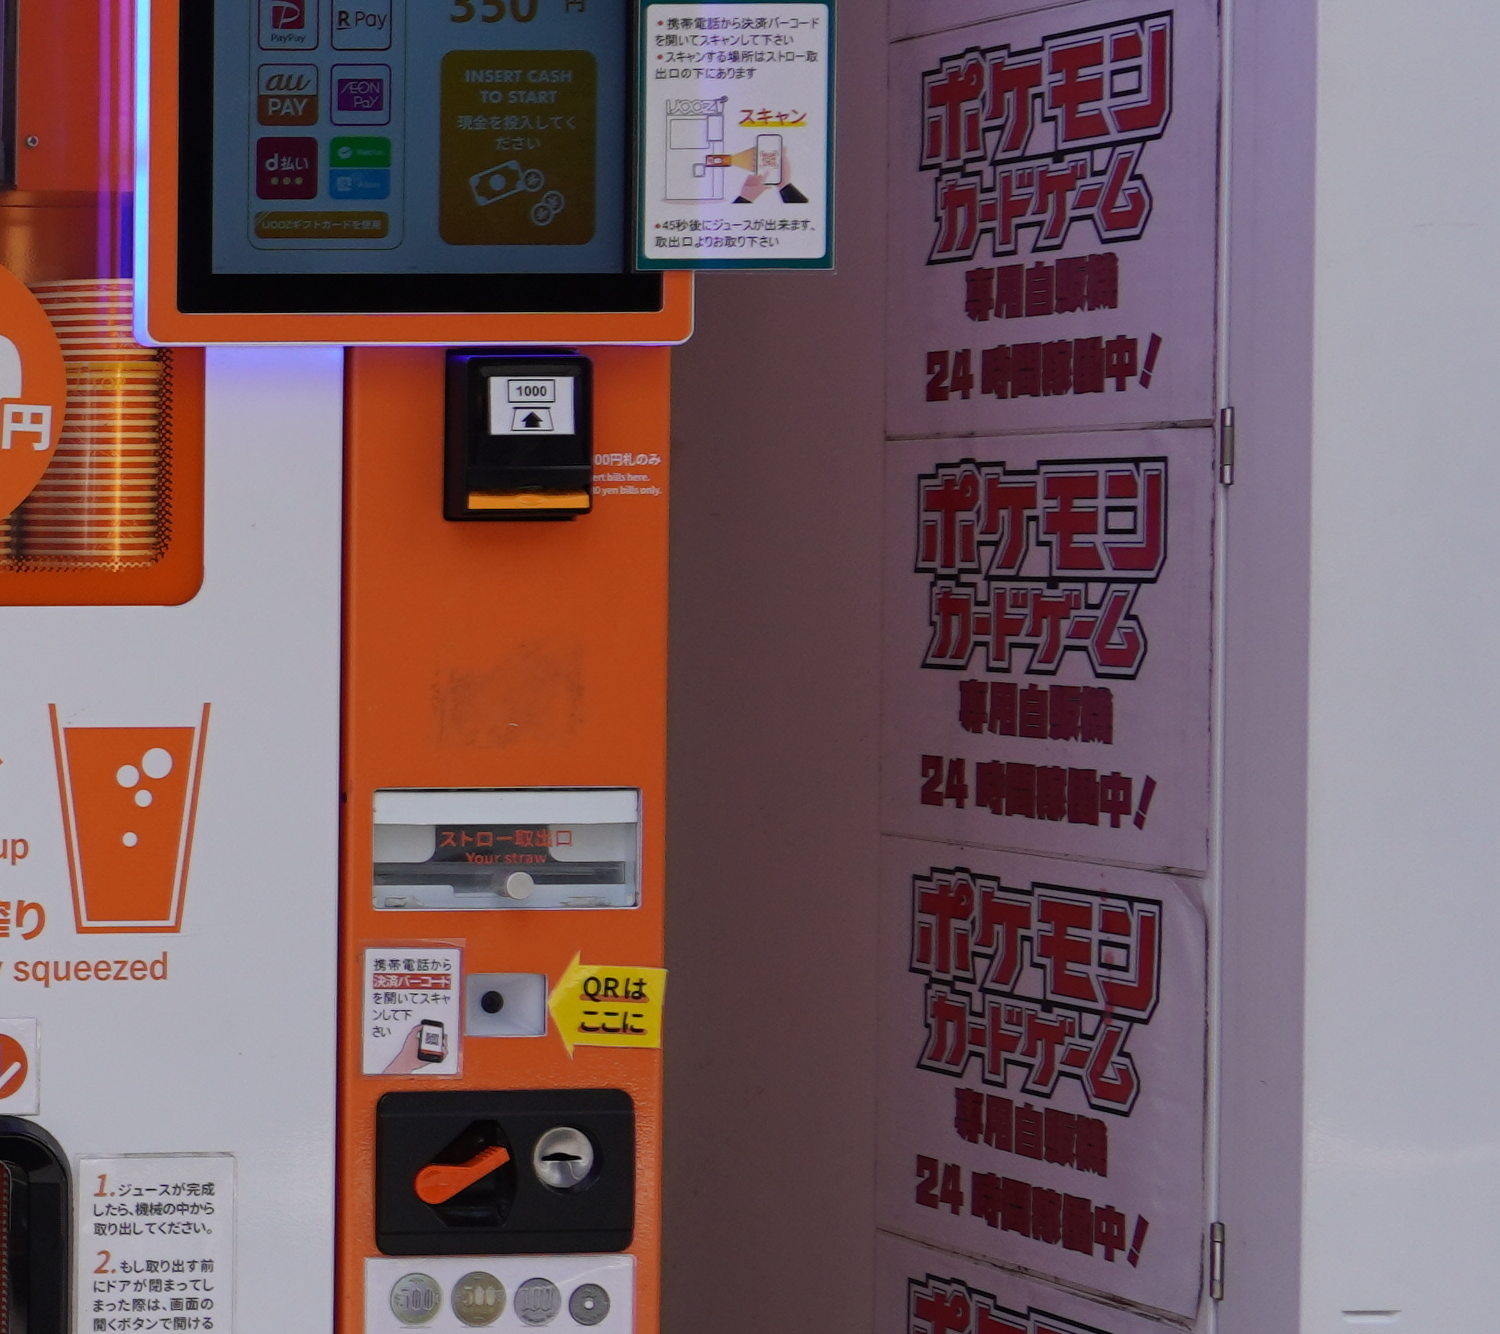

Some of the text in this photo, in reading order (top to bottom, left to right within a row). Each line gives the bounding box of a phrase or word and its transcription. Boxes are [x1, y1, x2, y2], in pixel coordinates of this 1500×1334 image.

[466, 70, 573, 83] INSERT CASH
[481, 91, 557, 103] TO START
[921, 11, 1173, 171] ポケモン
[739, 109, 807, 125] スキャン
[927, 152, 1152, 264] カードゲーム
[515, 385, 548, 398] 1000
[916, 458, 1167, 582] ポケモン
[923, 581, 1147, 679] カードゲーム
[440, 829, 572, 847] ストロー取出口
[466, 852, 546, 864] Your straw
[910, 869, 1162, 1022] ポケモン
[13, 952, 168, 988] squeezed
[373, 958, 452, 971] 携帯電話から
[583, 977, 647, 1002] QRは
[581, 1011, 645, 1032] ここに
[916, 984, 1139, 1116] カードゲーム
